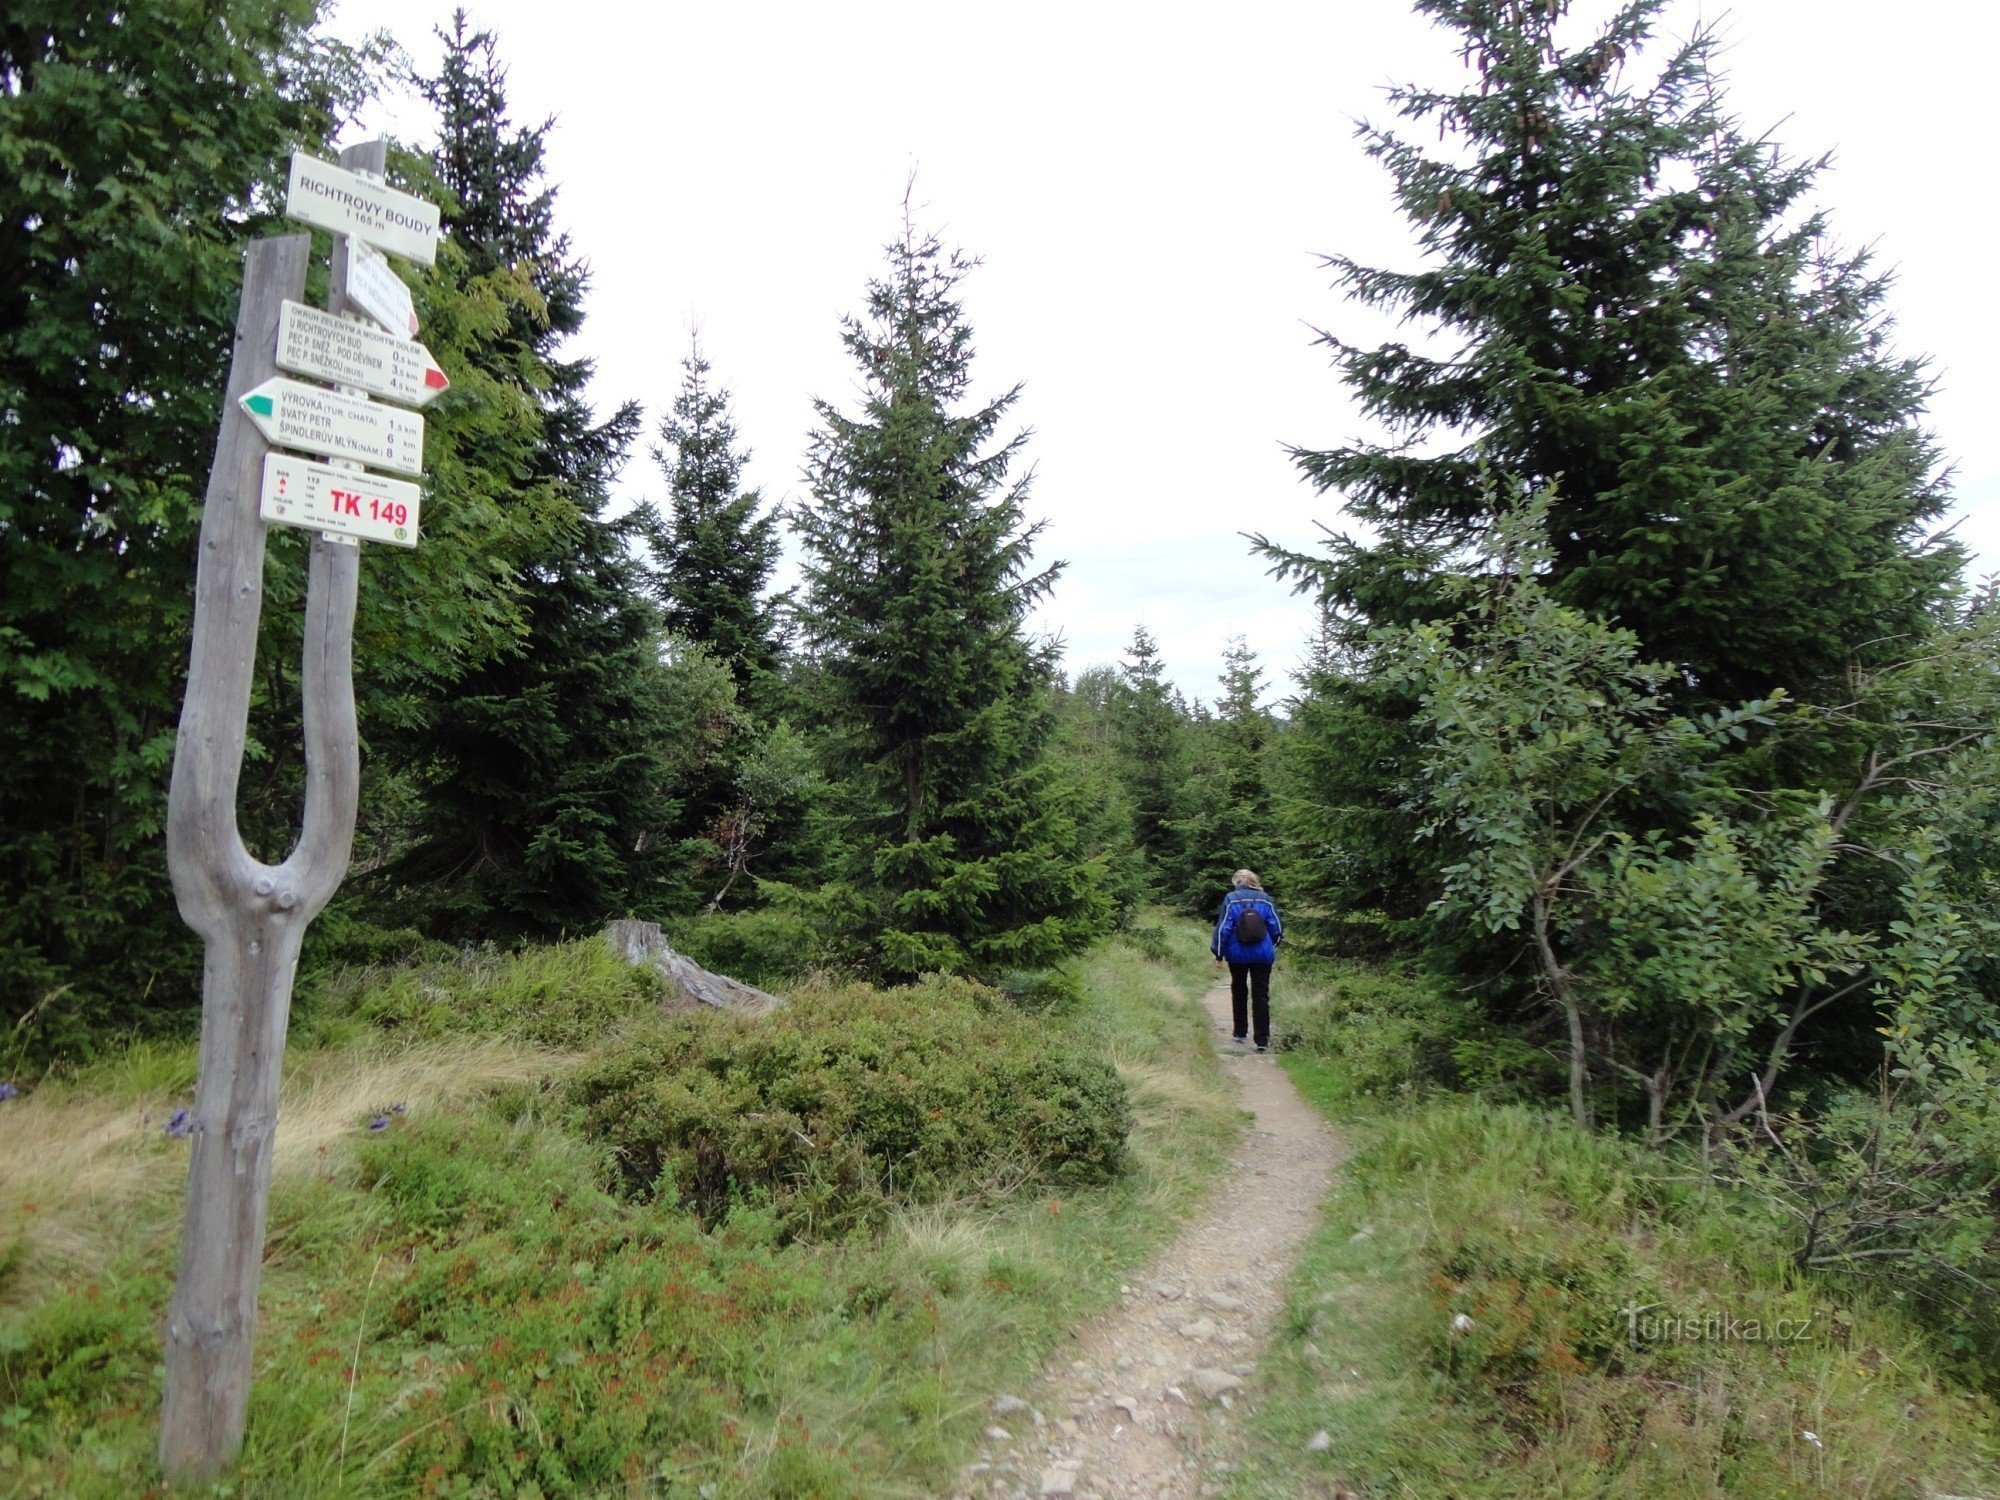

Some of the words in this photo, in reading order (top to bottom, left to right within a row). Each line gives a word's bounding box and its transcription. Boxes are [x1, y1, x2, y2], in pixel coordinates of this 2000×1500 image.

[300, 175, 382, 217] RICHTROVY
[386, 207, 431, 236] BOUDY
[355, 212, 373, 226] 165
[375, 221, 385, 231] m
[289, 317, 295, 328] U
[347, 336, 362, 349] BUD
[407, 358, 419, 368] km
[291, 307, 319, 323] OKRUH
[356, 328, 363, 336] A
[396, 341, 421, 355] DOLEM
[286, 345, 301, 358] PEC
[405, 384, 417, 394] km
[288, 332, 302, 345] PEC
[337, 346, 352, 360] POD
[406, 371, 418, 381] km
[309, 413, 332, 429] PETR
[387, 433, 394, 444] 6
[403, 440, 416, 449] km
[348, 411, 378, 426] CHATA)
[404, 426, 417, 435] km
[386, 448, 393, 459] 8
[402, 454, 415, 464] km
[331, 489, 362, 517] TK
[369, 498, 407, 526] 149
